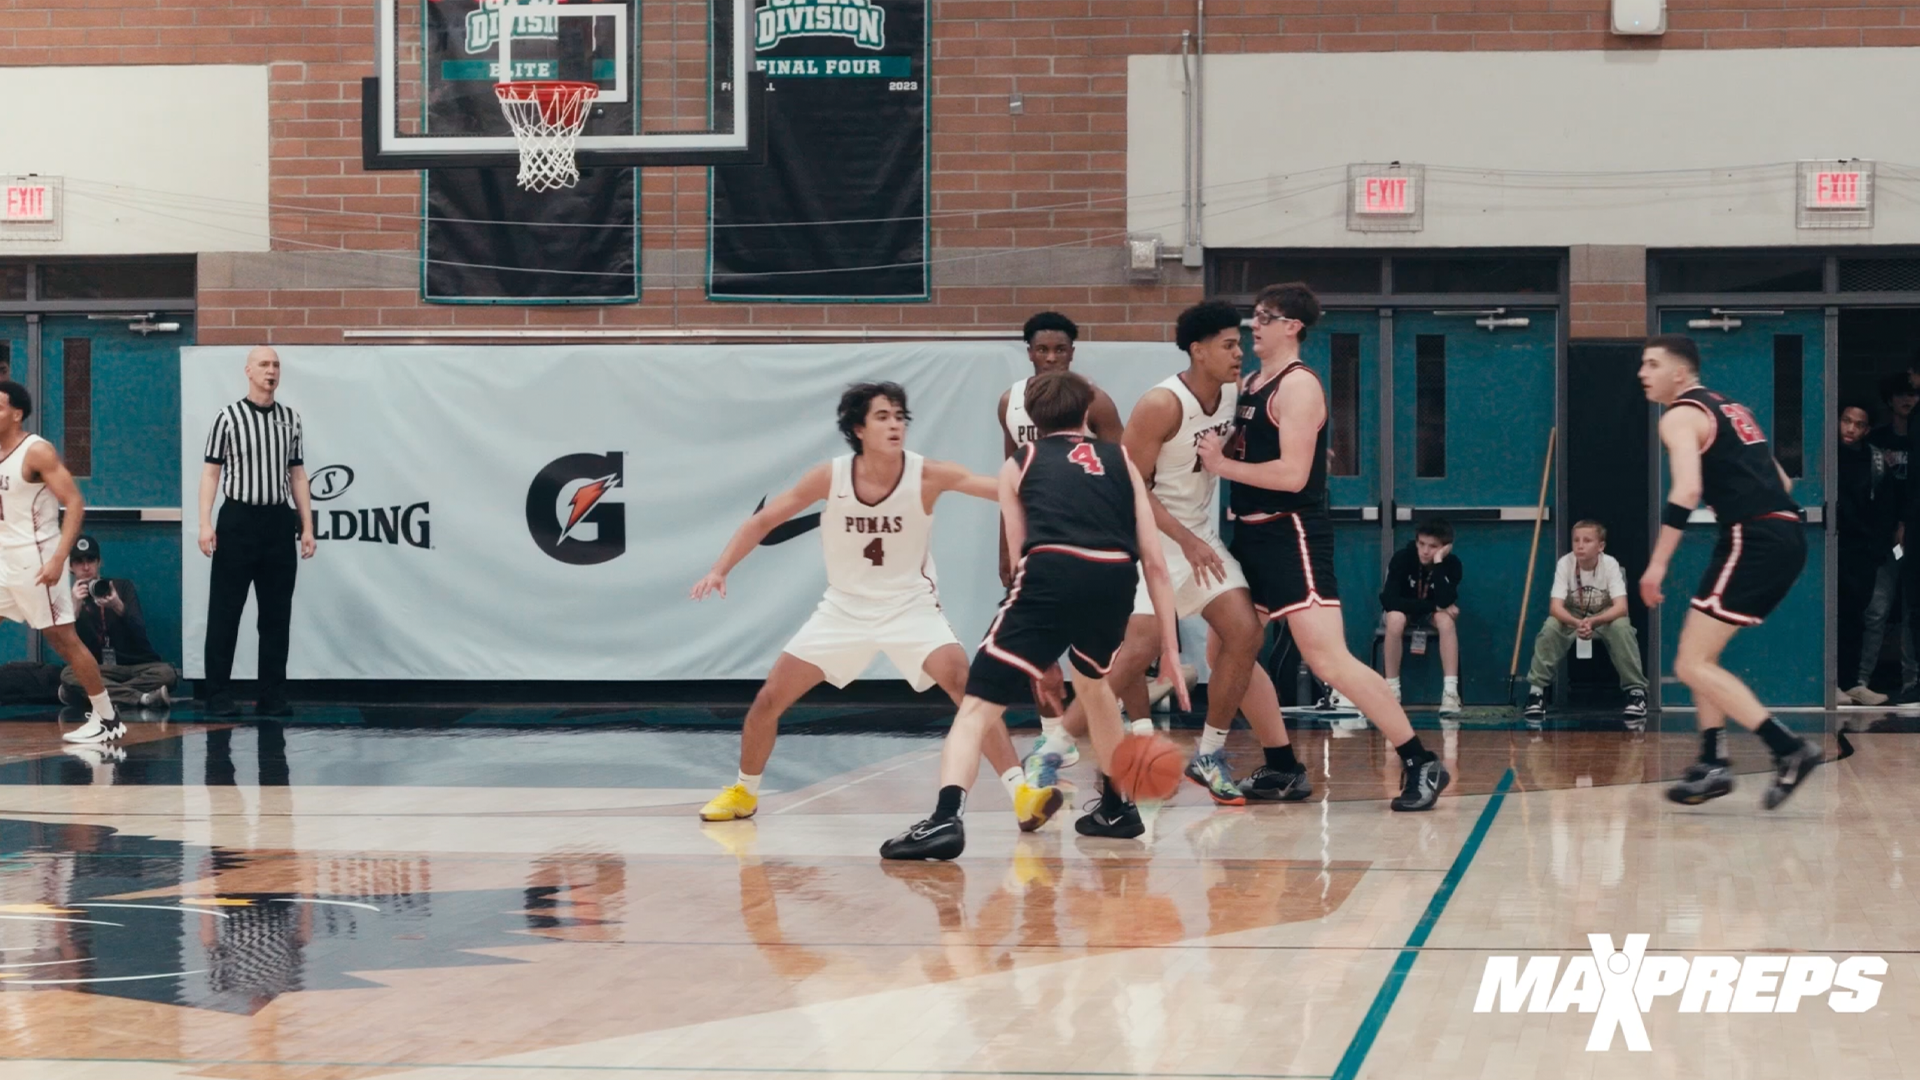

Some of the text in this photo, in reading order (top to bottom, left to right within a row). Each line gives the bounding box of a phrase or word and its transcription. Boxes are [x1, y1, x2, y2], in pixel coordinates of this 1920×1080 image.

[757, 5, 880, 45] DIVISION
[489, 63, 550, 77] EITE
[755, 60, 881, 74] FINAL FOUR
[888, 82, 918, 91] 2023
[7, 187, 45, 215] EXIT
[1366, 179, 1407, 210] EXIT
[1818, 173, 1859, 204] EXIT
[1067, 442, 1105, 475] 4
[525, 451, 626, 565] G
[308, 501, 431, 550] LDING
[845, 515, 903, 533] PUMAS
[863, 537, 884, 566] 4
